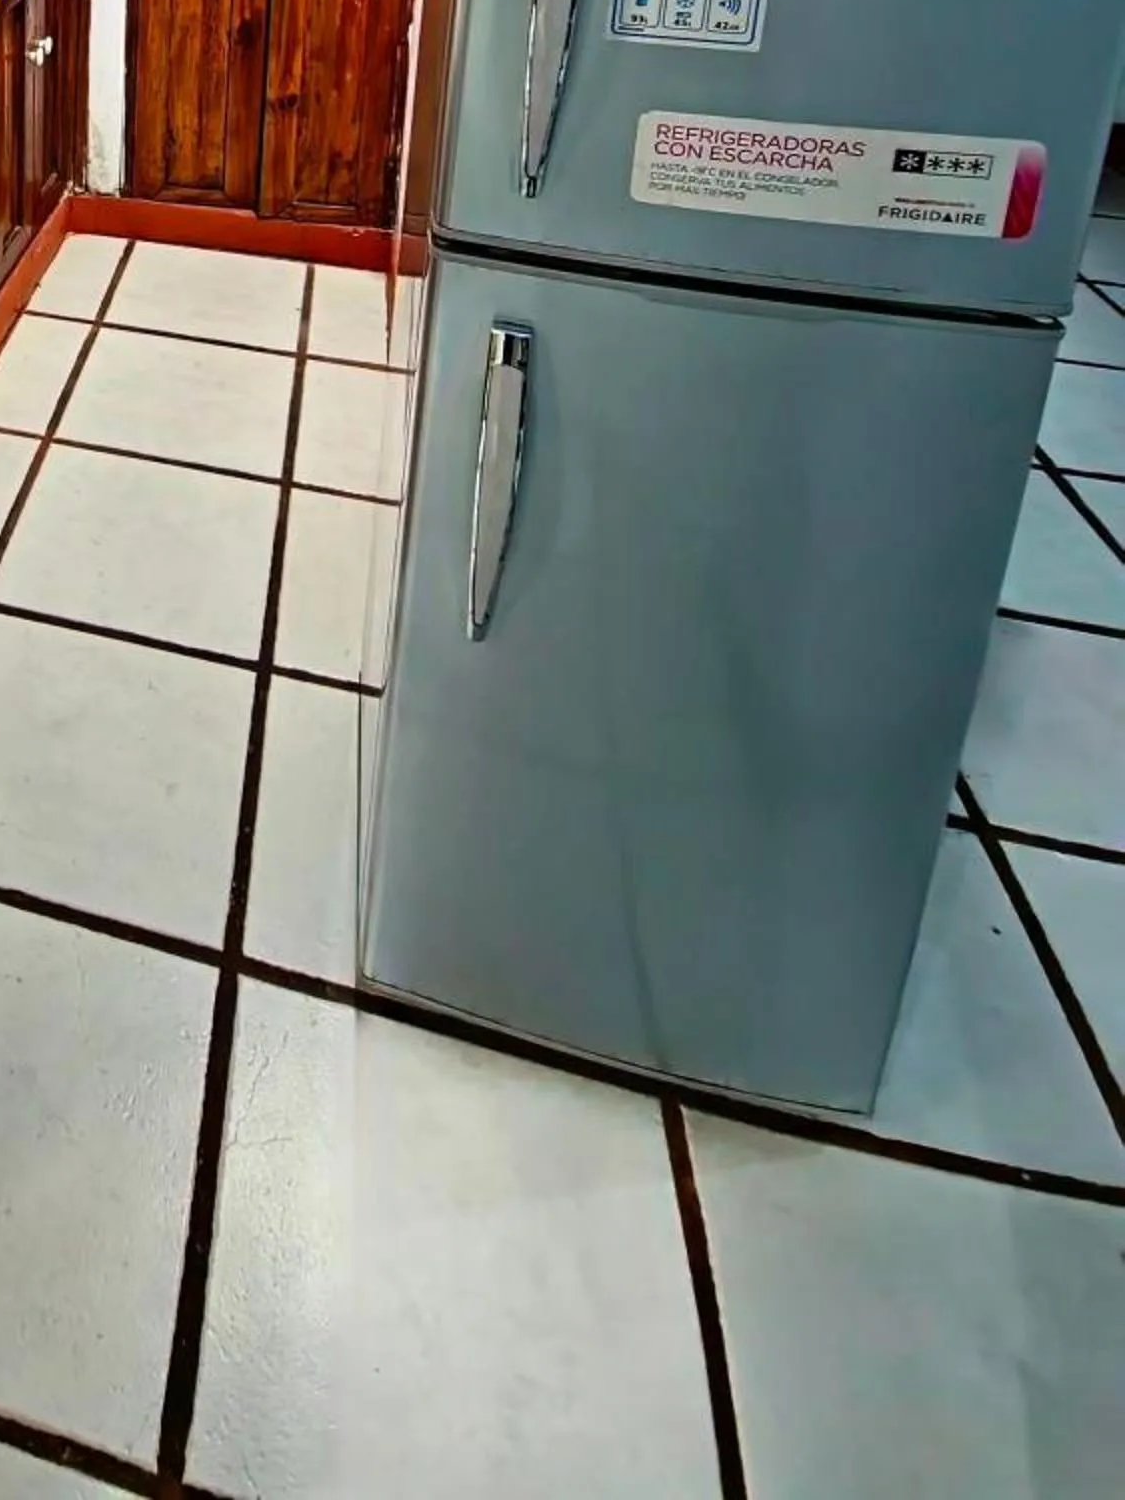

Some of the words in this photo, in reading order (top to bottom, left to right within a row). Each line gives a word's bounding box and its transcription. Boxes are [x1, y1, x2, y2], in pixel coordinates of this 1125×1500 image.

[655, 123, 867, 157] REFRIGERADORAS
[654, 141, 703, 160] CON
[709, 145, 834, 173] ESCARCHA
[878, 205, 987, 226] FRIGIDAIRE
